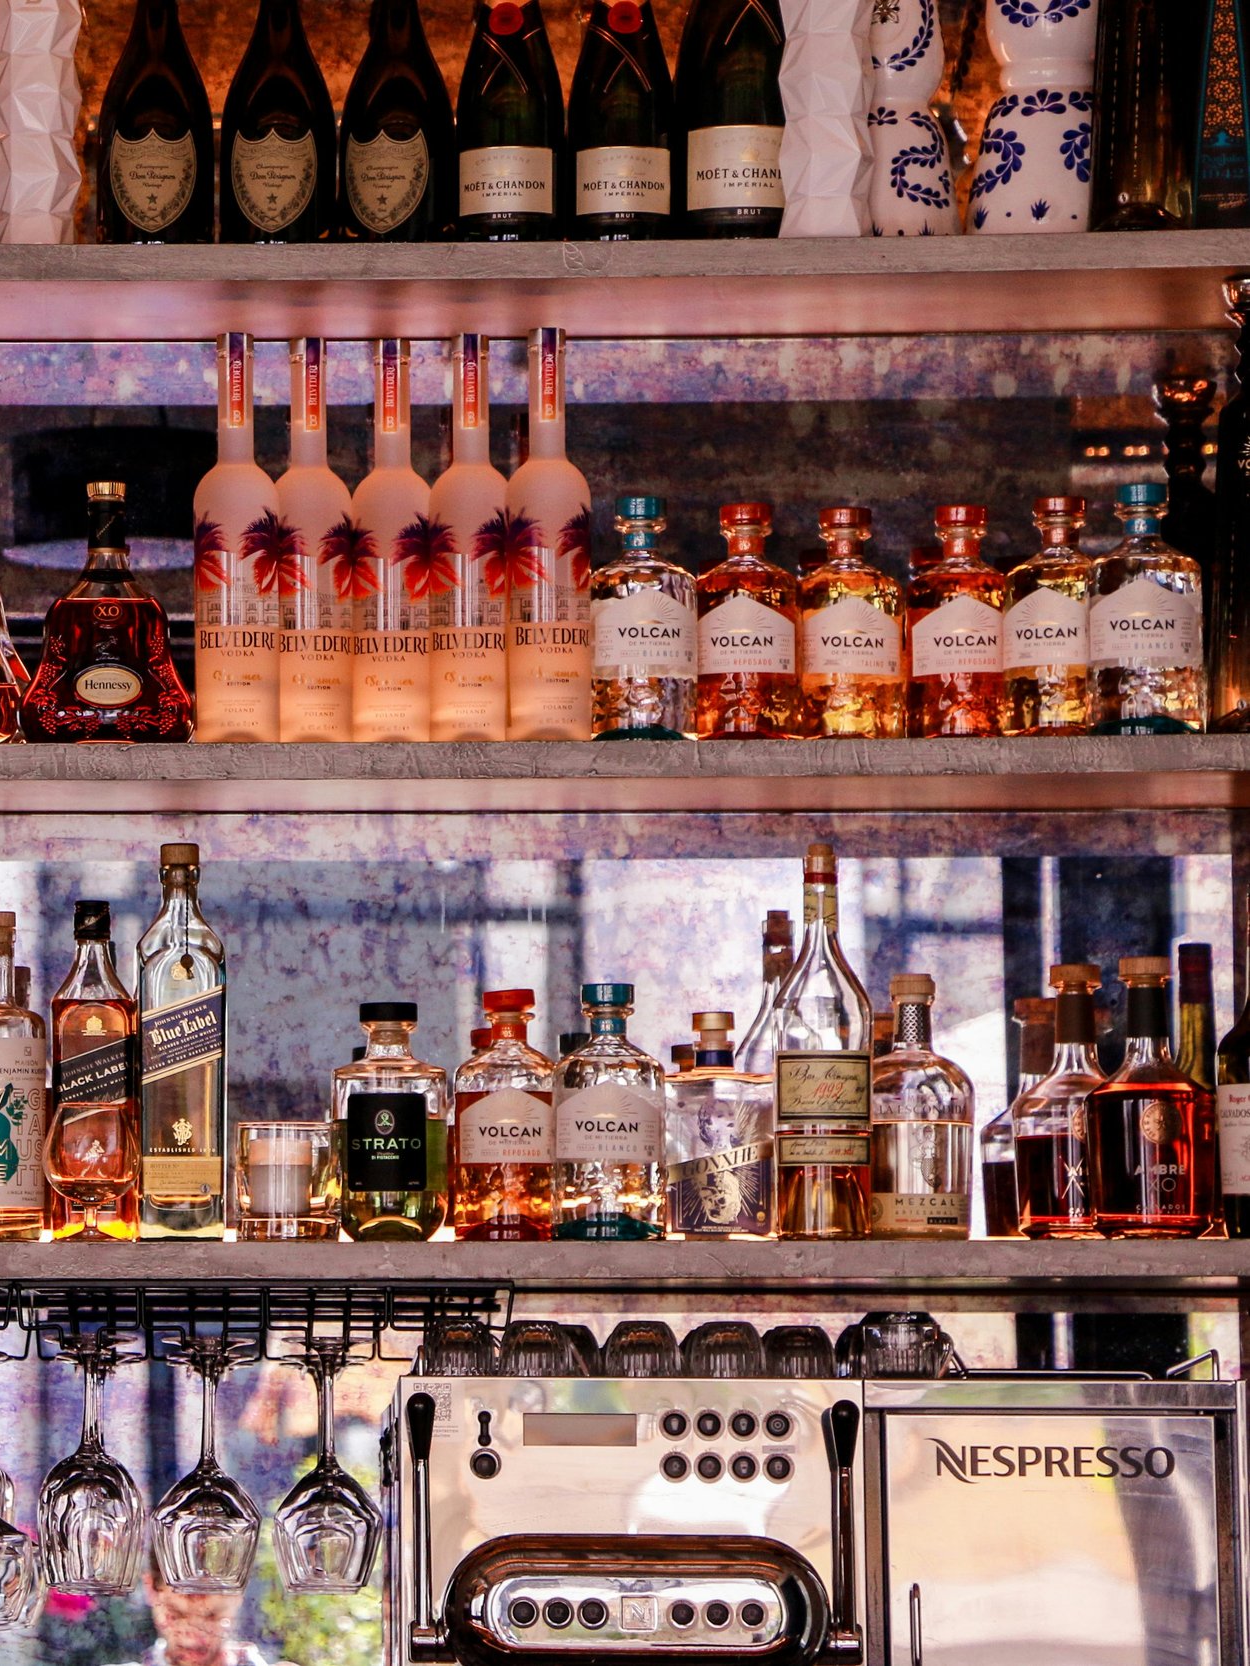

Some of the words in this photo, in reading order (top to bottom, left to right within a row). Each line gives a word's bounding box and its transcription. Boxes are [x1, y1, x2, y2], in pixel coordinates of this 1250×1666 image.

[129, 171, 146, 180] Dom
[249, 171, 267, 181] Dom
[360, 172, 377, 182] Dom
[696, 167, 729, 181] MOËT
[743, 168, 781, 180] CHAN
[463, 180, 487, 193] MOËT
[495, 180, 546, 192] CHANDON
[583, 180, 610, 193] MOËT
[618, 180, 665, 192] CHANDON
[736, 208, 762, 216] BRUT
[1109, 619, 1175, 632] VOLCAN
[617, 627, 681, 639] VOLCAN
[1015, 627, 1078, 640] VOLCAN
[200, 630, 276, 651] BELVEDERE
[353, 636, 429, 656] BELVEDERE
[710, 635, 774, 648] VOLCAN
[821, 636, 884, 649] VOLCAN
[933, 634, 997, 647] VOLCAN
[1134, 641, 1175, 650] BLANCO
[300, 653, 335, 662] VODKA
[371, 655, 406, 663] VODKA
[642, 649, 680, 658] BLANCO
[733, 658, 773, 666] REPOSADO
[957, 657, 997, 666] REPOSADO
[84, 679, 133, 692] Hennessy
[154, 1012, 181, 1028] JOHNNIE
[182, 1004, 208, 1018] WALKER
[148, 1022, 185, 1046] Blue
[182, 1010, 218, 1034] Label
[62, 1062, 94, 1080] JOHNNIE
[94, 1051, 126, 1070] WALKER
[478, 1126, 542, 1138] VOLCAN
[575, 1121, 639, 1133] VOLCAN
[351, 1138, 422, 1151] STRATO
[502, 1149, 541, 1158] REPOSADO
[1134, 1164, 1186, 1176] AMBRE
[895, 1198, 956, 1207] MEZCAL
[924, 1437, 1176, 1485] NESPRESSO
